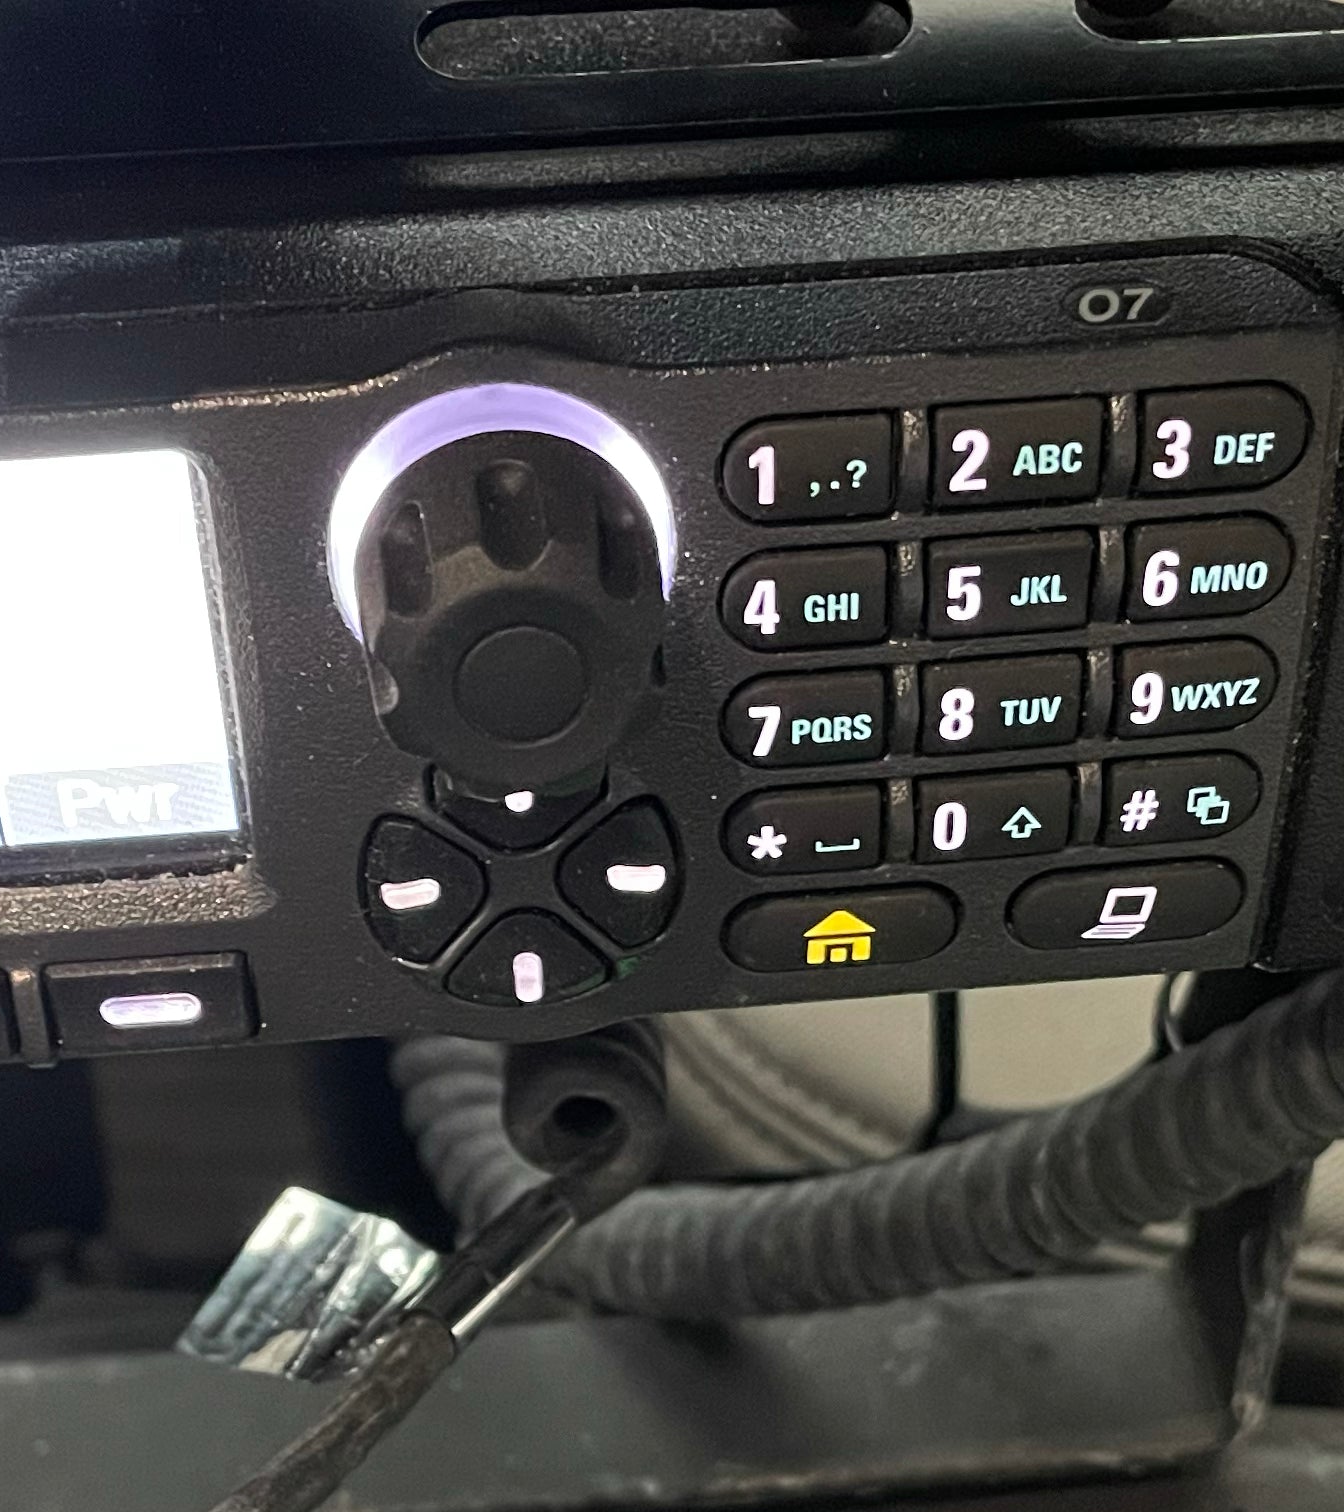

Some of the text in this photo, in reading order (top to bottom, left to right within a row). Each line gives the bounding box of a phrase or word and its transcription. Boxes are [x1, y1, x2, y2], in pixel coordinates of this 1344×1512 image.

[749, 446, 774, 504] 1
[949, 429, 1082, 491] 2 ABC
[1153, 420, 1275, 478] 3 DEF
[947, 566, 1067, 620] 5 JKL
[1143, 550, 1268, 606] 6 MNO
[744, 580, 859, 634] 4 GHI
[939, 688, 1061, 740] 8 TUV
[1130, 671, 1260, 724] 9 WXYZ
[749, 706, 872, 756] 7 PQRS
[56, 777, 180, 830] Pwr
[933, 802, 967, 850] 0
